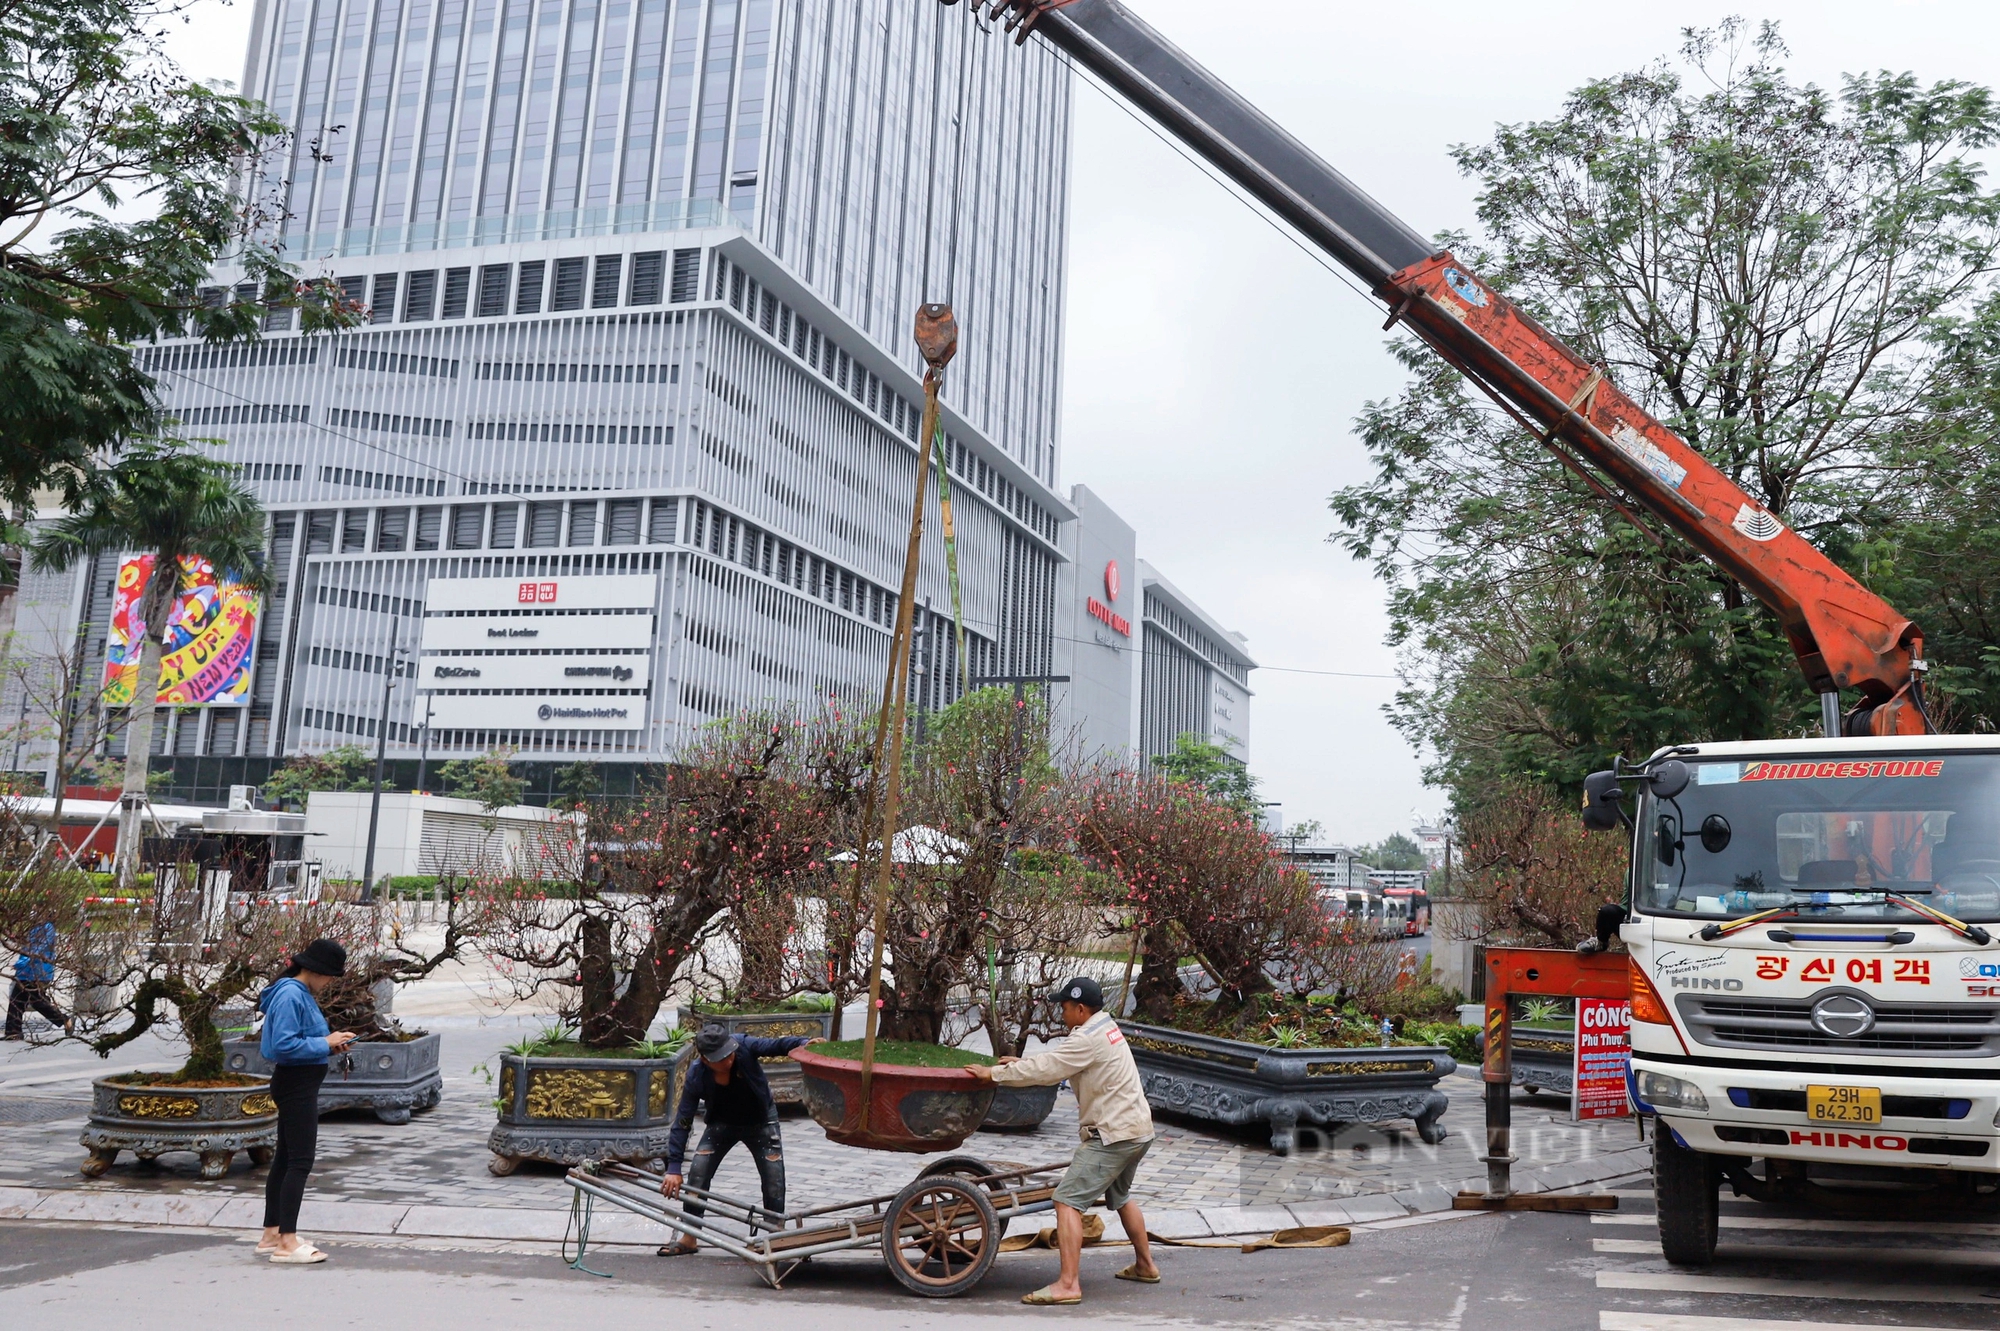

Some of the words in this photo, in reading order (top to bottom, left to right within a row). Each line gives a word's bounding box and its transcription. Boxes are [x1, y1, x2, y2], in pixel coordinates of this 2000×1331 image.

[1087, 596, 1113, 627] LOTTE
[488, 628, 507, 637] Foot
[509, 628, 539, 637] Locker
[189, 627, 225, 665] UP!
[187, 664, 223, 700] NEW
[1740, 760, 1945, 782] BRIDGESTONE
[1666, 965, 1692, 975] Produced
[1756, 956, 1930, 984] 광신여객
[1671, 976, 1743, 991] HINO
[1581, 1033, 1598, 1047] Phú
[1828, 1088, 1859, 1103] 29H
[1816, 1104, 1873, 1121] 842.30
[1790, 1131, 1907, 1151] HINO
